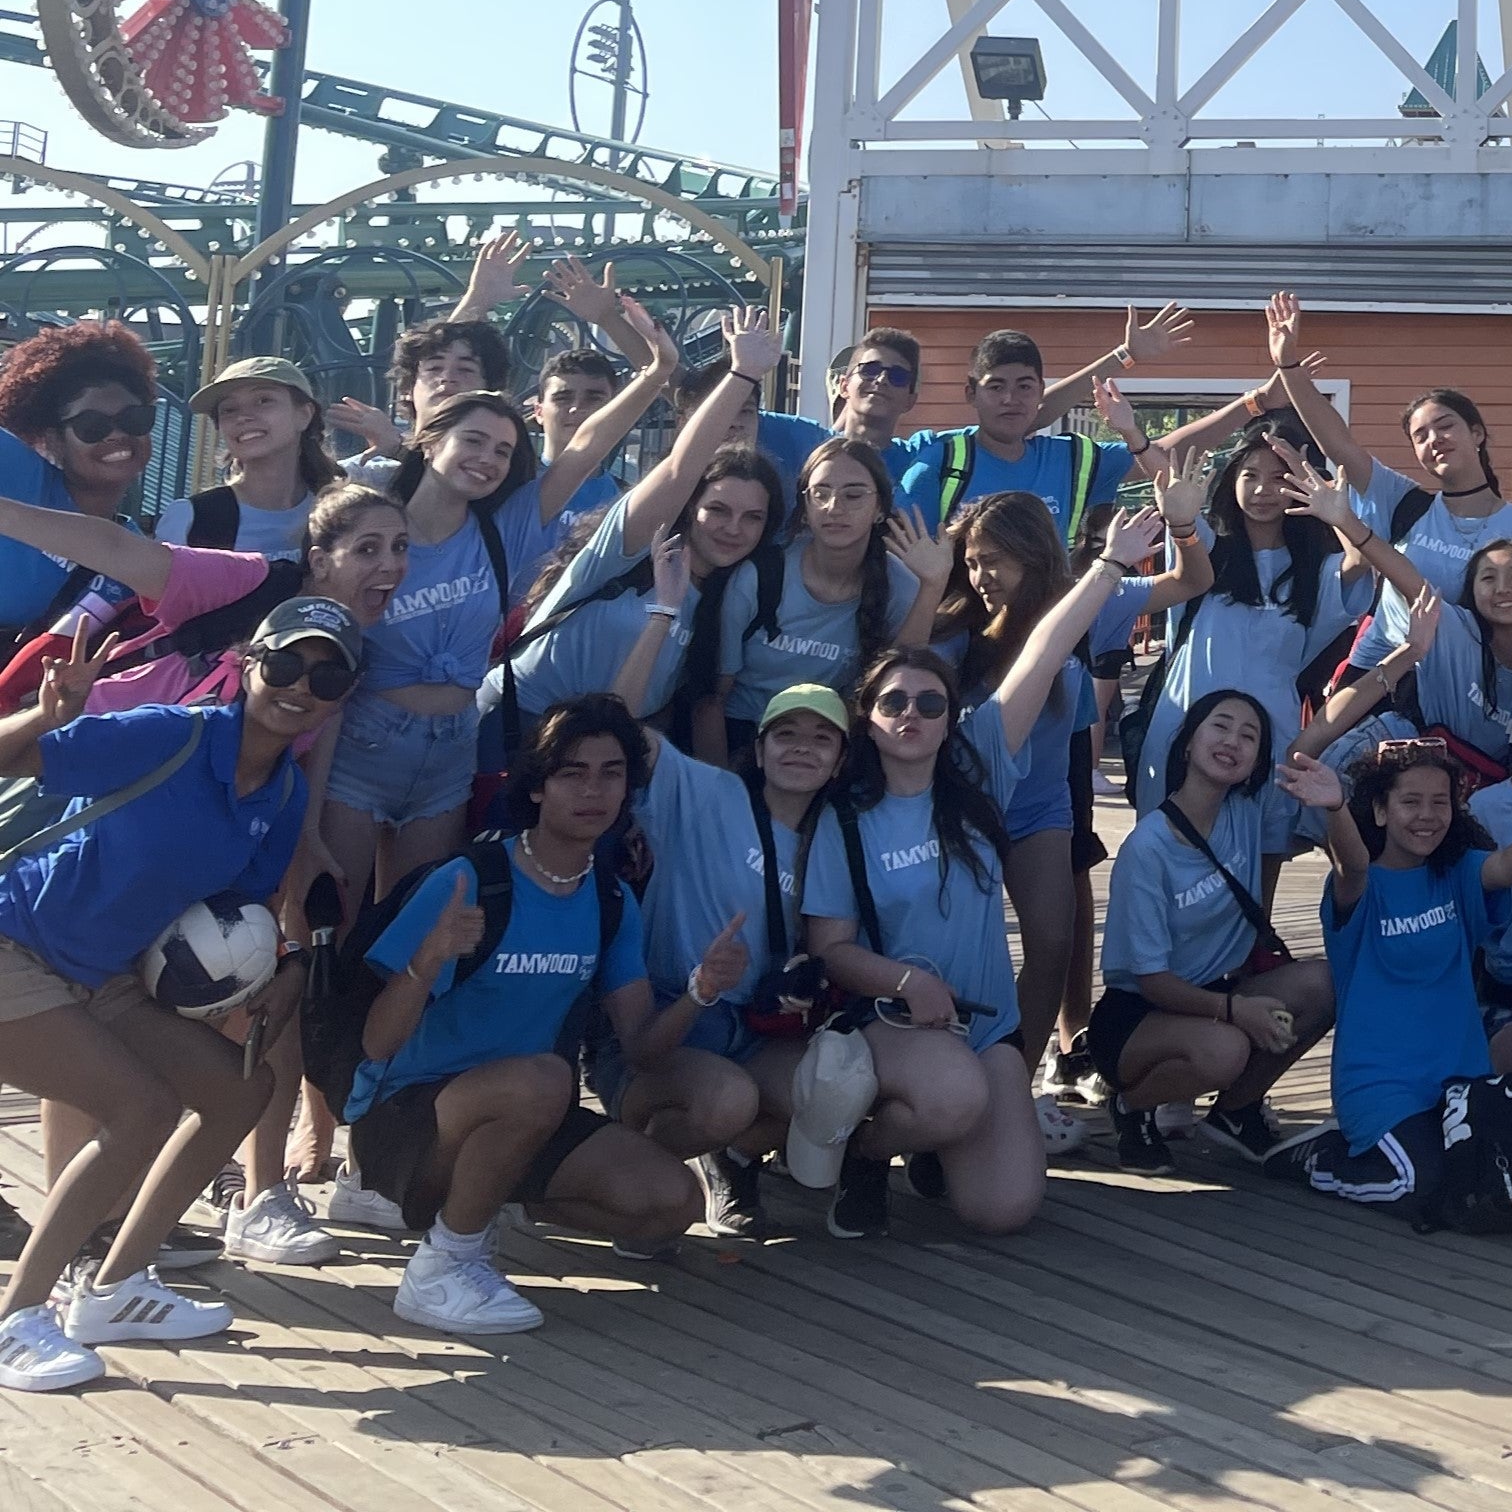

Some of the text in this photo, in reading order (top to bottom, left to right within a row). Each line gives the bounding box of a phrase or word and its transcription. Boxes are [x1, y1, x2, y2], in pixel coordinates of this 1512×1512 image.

[881, 840, 939, 871] TAMWO
[1380, 906, 1446, 937] TAMWOOD
[496, 953, 579, 974] TAMWOOD
